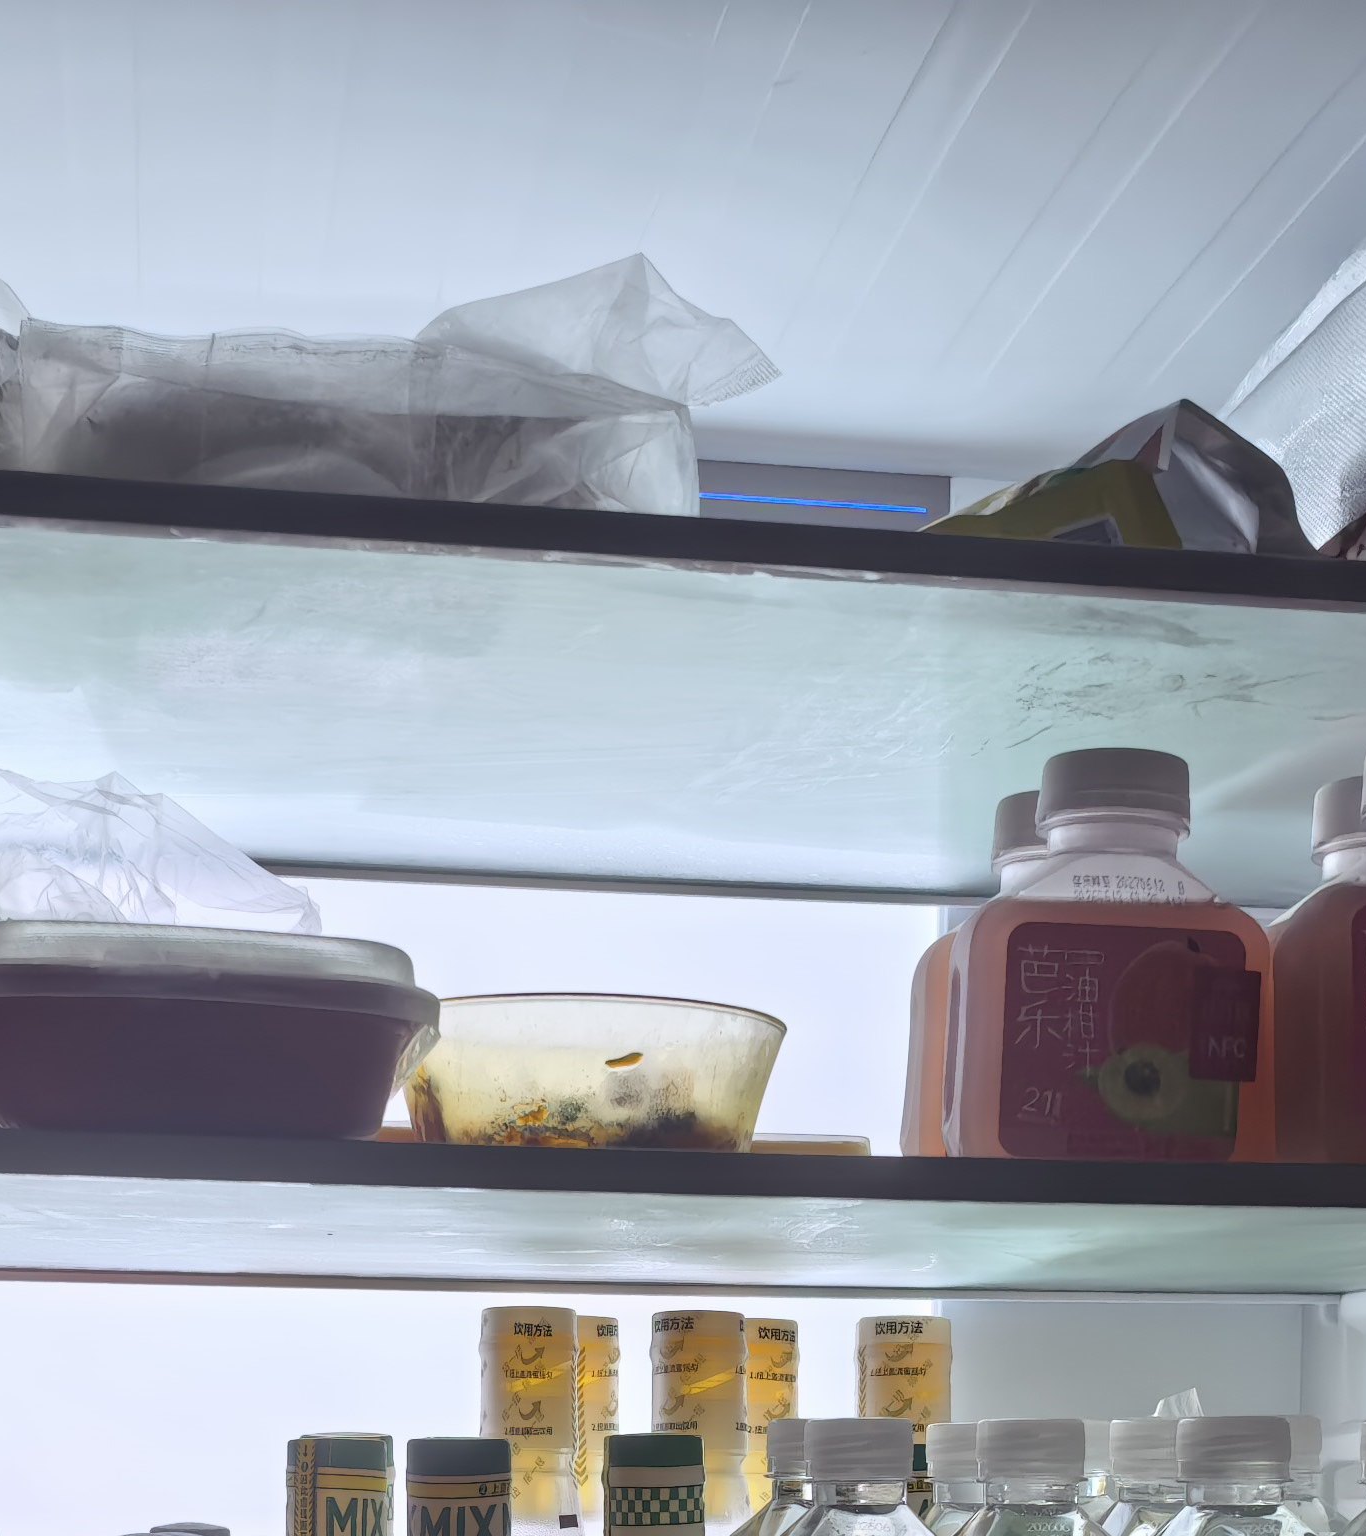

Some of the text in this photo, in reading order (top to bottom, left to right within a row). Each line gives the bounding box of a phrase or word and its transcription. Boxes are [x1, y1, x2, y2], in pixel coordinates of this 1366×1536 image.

[1014, 943, 1065, 1048] 芭乐
[1207, 1037, 1246, 1058] NFC
[513, 1322, 553, 1338] 饮用方法
[758, 1326, 796, 1343] 饮用方法
[875, 1320, 924, 1336] 饮用方法
